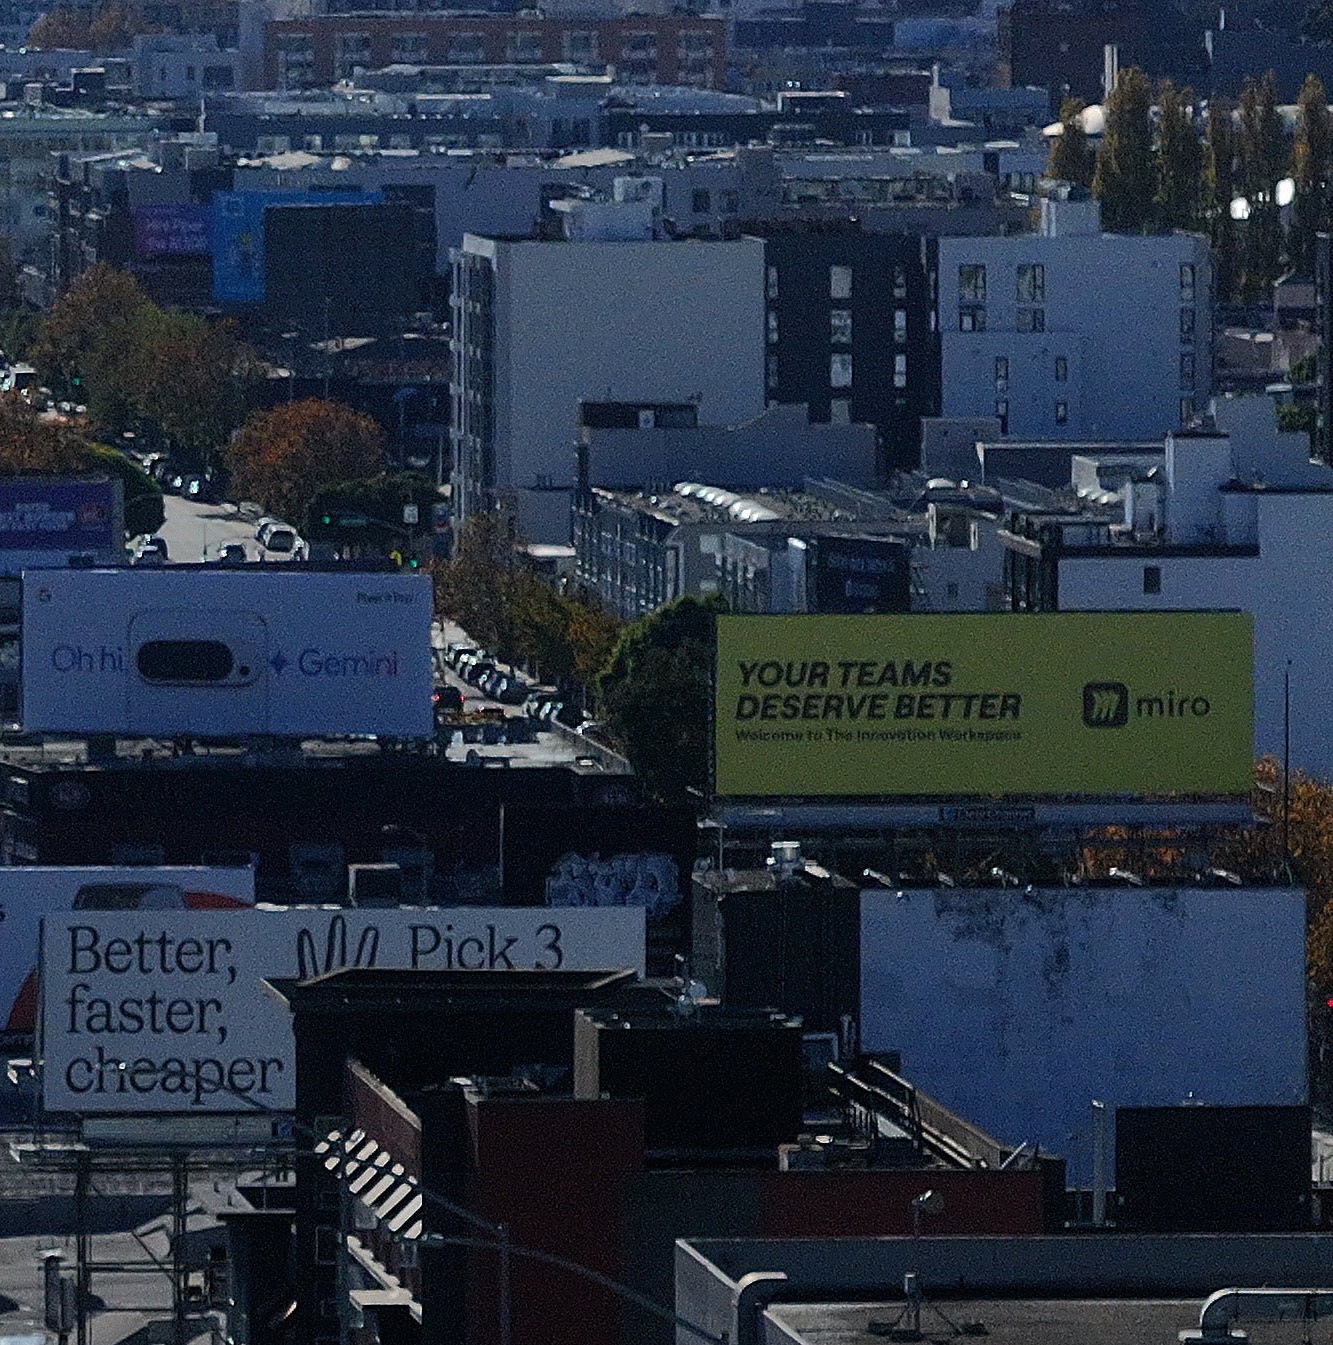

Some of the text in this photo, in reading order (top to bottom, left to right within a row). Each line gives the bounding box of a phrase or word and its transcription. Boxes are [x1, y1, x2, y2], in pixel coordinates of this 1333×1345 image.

[52, 645, 92, 673] Oh
[298, 649, 398, 677] Gemini
[738, 662, 953, 687] YOUR TEAMS
[735, 694, 1021, 720] DESERVE BETTER
[1136, 690, 1210, 718] miro
[735, 729, 804, 742] Welcome
[808, 730, 822, 742] to
[826, 729, 852, 742] The
[857, 729, 933, 742] Innovation
[66, 925, 239, 983] Better,
[409, 922, 563, 970] Pick 3
[65, 983, 228, 1044] faster,
[65, 1047, 283, 1106] cheaper
